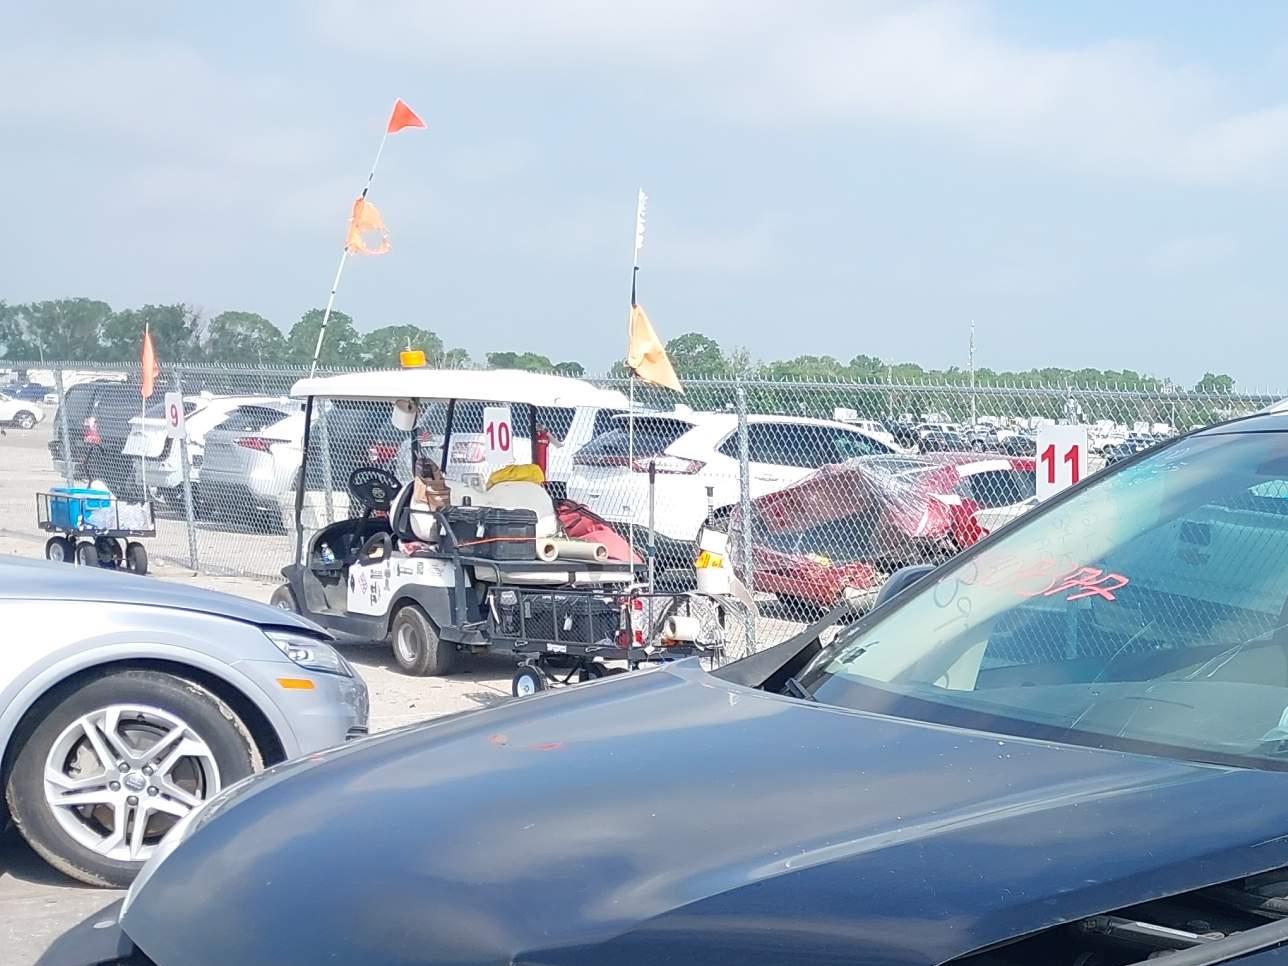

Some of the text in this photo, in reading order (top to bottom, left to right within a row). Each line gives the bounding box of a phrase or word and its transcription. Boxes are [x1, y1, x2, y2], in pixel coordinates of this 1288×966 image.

[170, 403, 179, 428] 9
[486, 421, 510, 452] 10
[1041, 443, 1079, 486] 11
